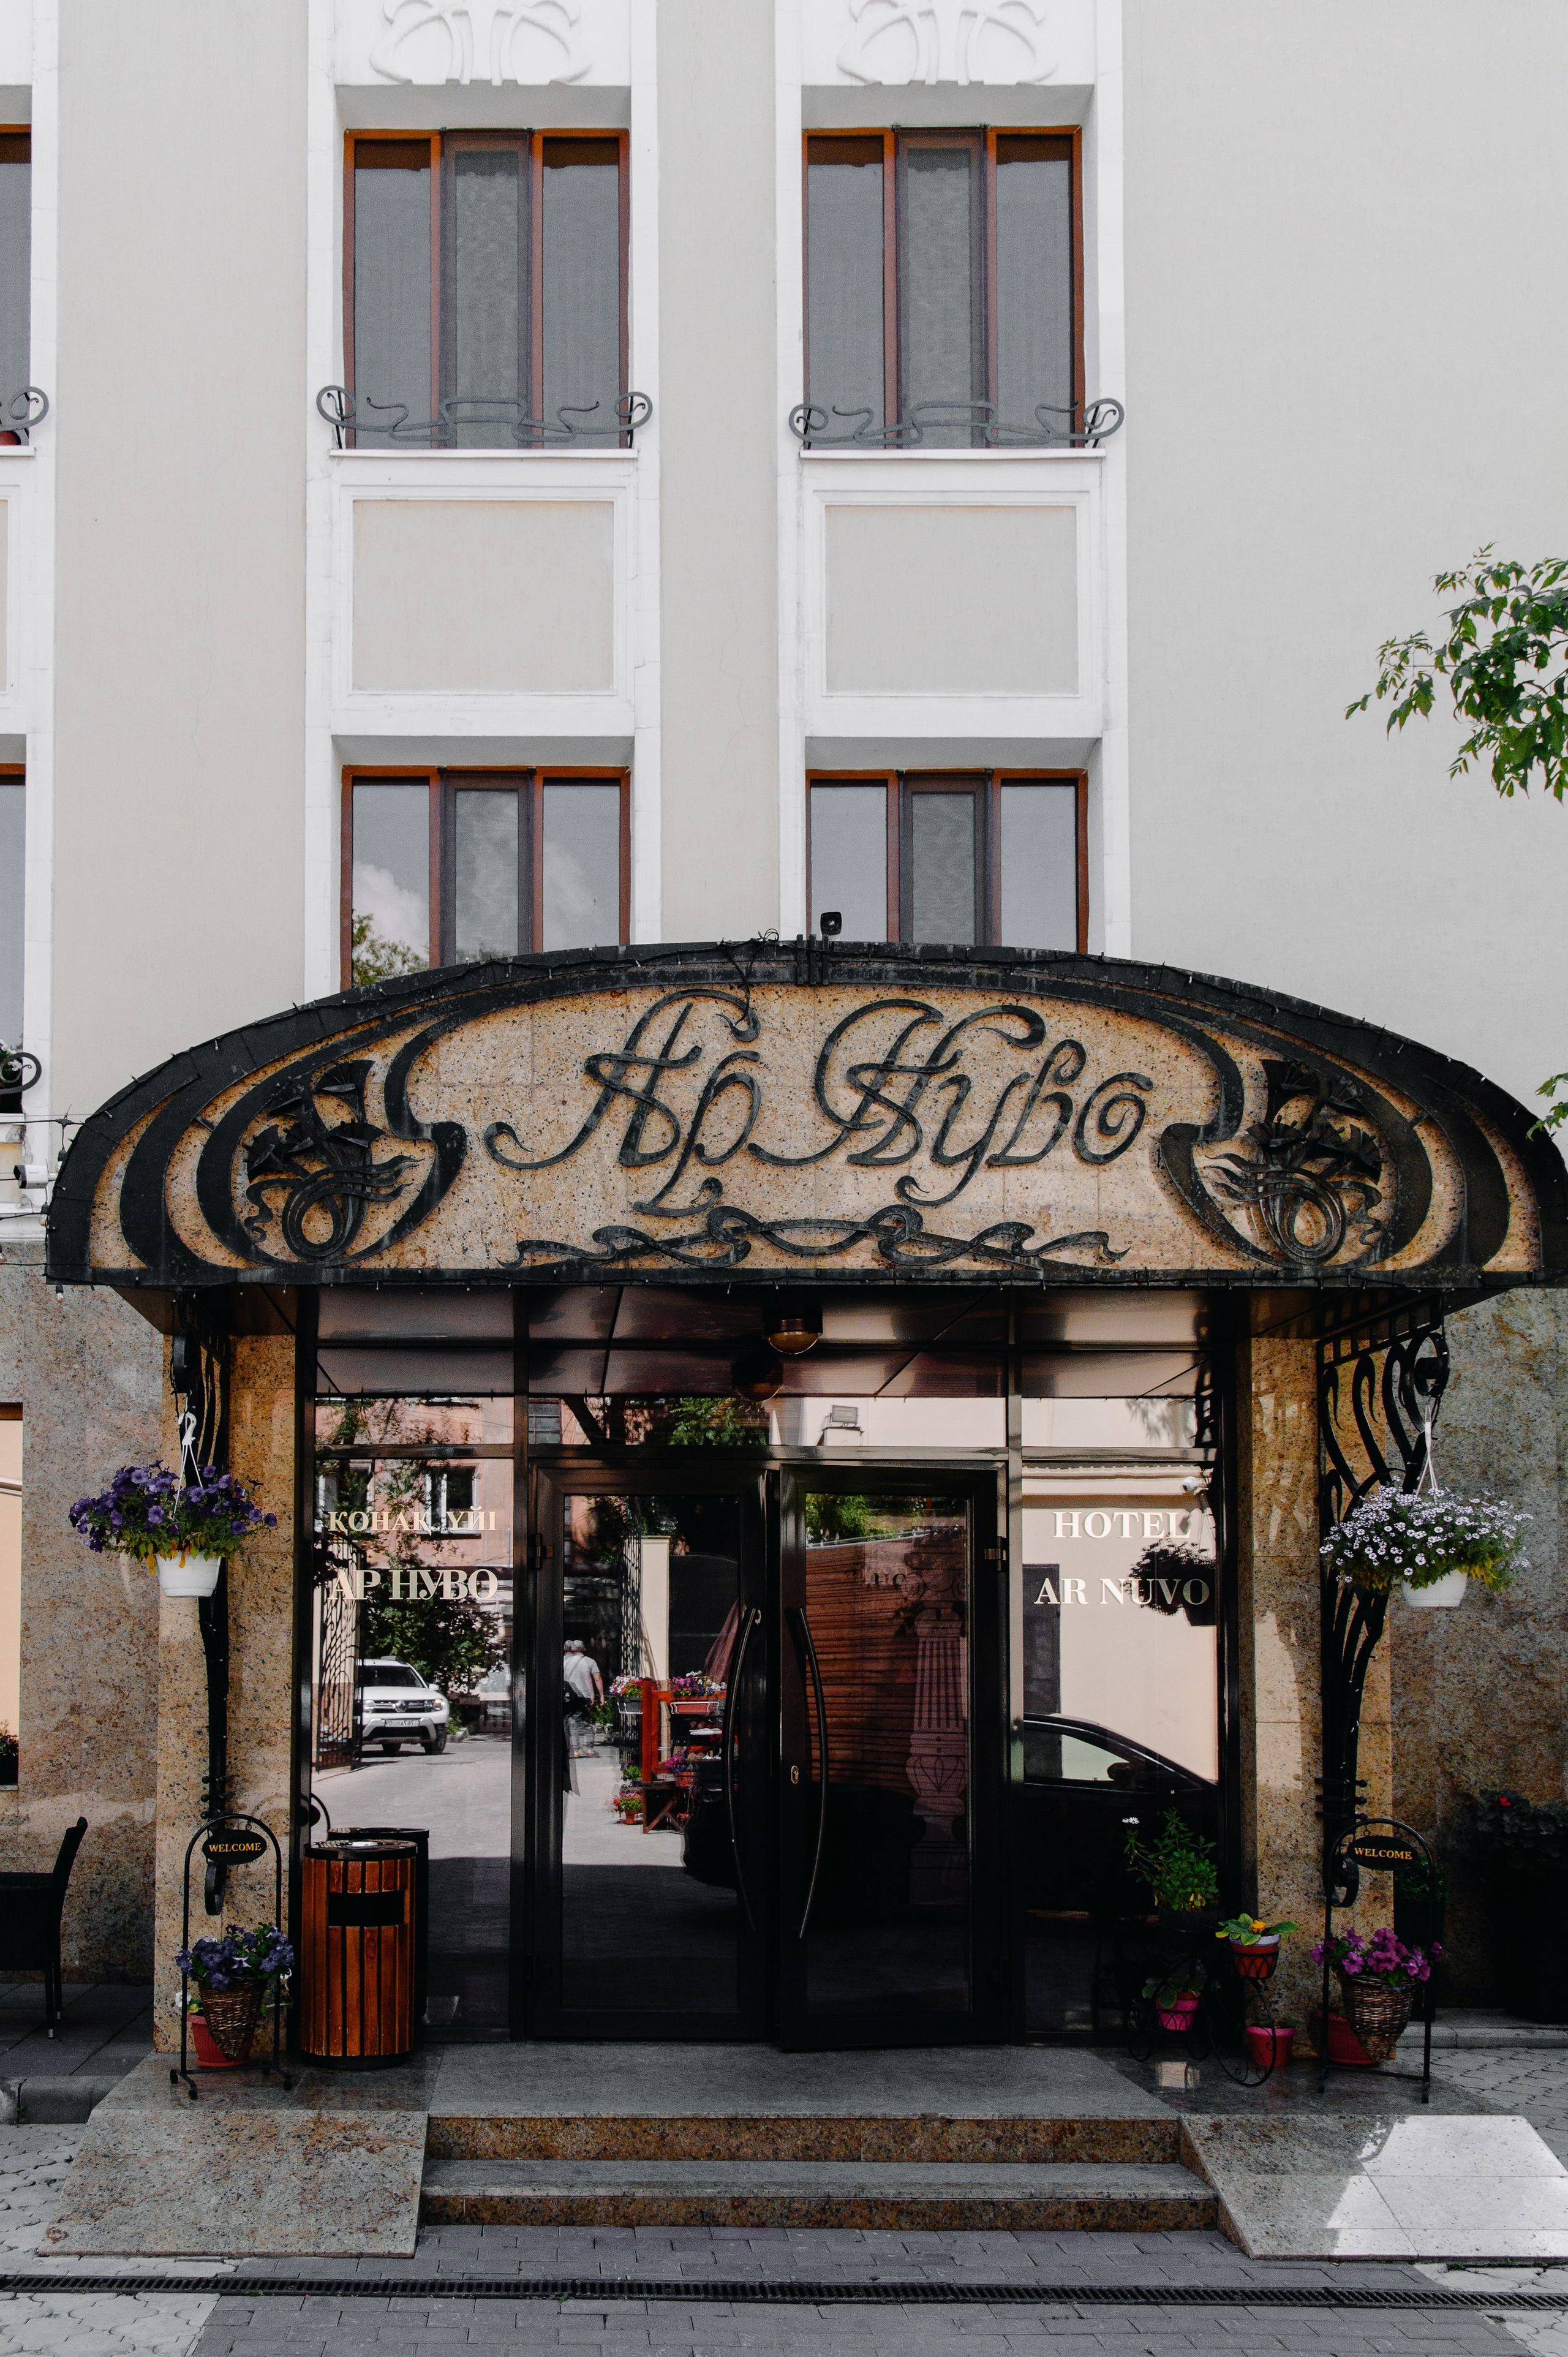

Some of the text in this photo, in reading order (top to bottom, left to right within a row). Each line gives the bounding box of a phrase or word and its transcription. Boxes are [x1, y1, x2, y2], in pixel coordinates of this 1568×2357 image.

[483, 988, 762, 1217] Ар
[1052, 1511, 1191, 1539] HOTEL
[327, 1569, 499, 1601] АР НУВО
[1033, 1577, 1210, 1605] AR NUVO
[209, 1842, 262, 1852] WELCOME
[1354, 1847, 1413, 1860] WELCOME
